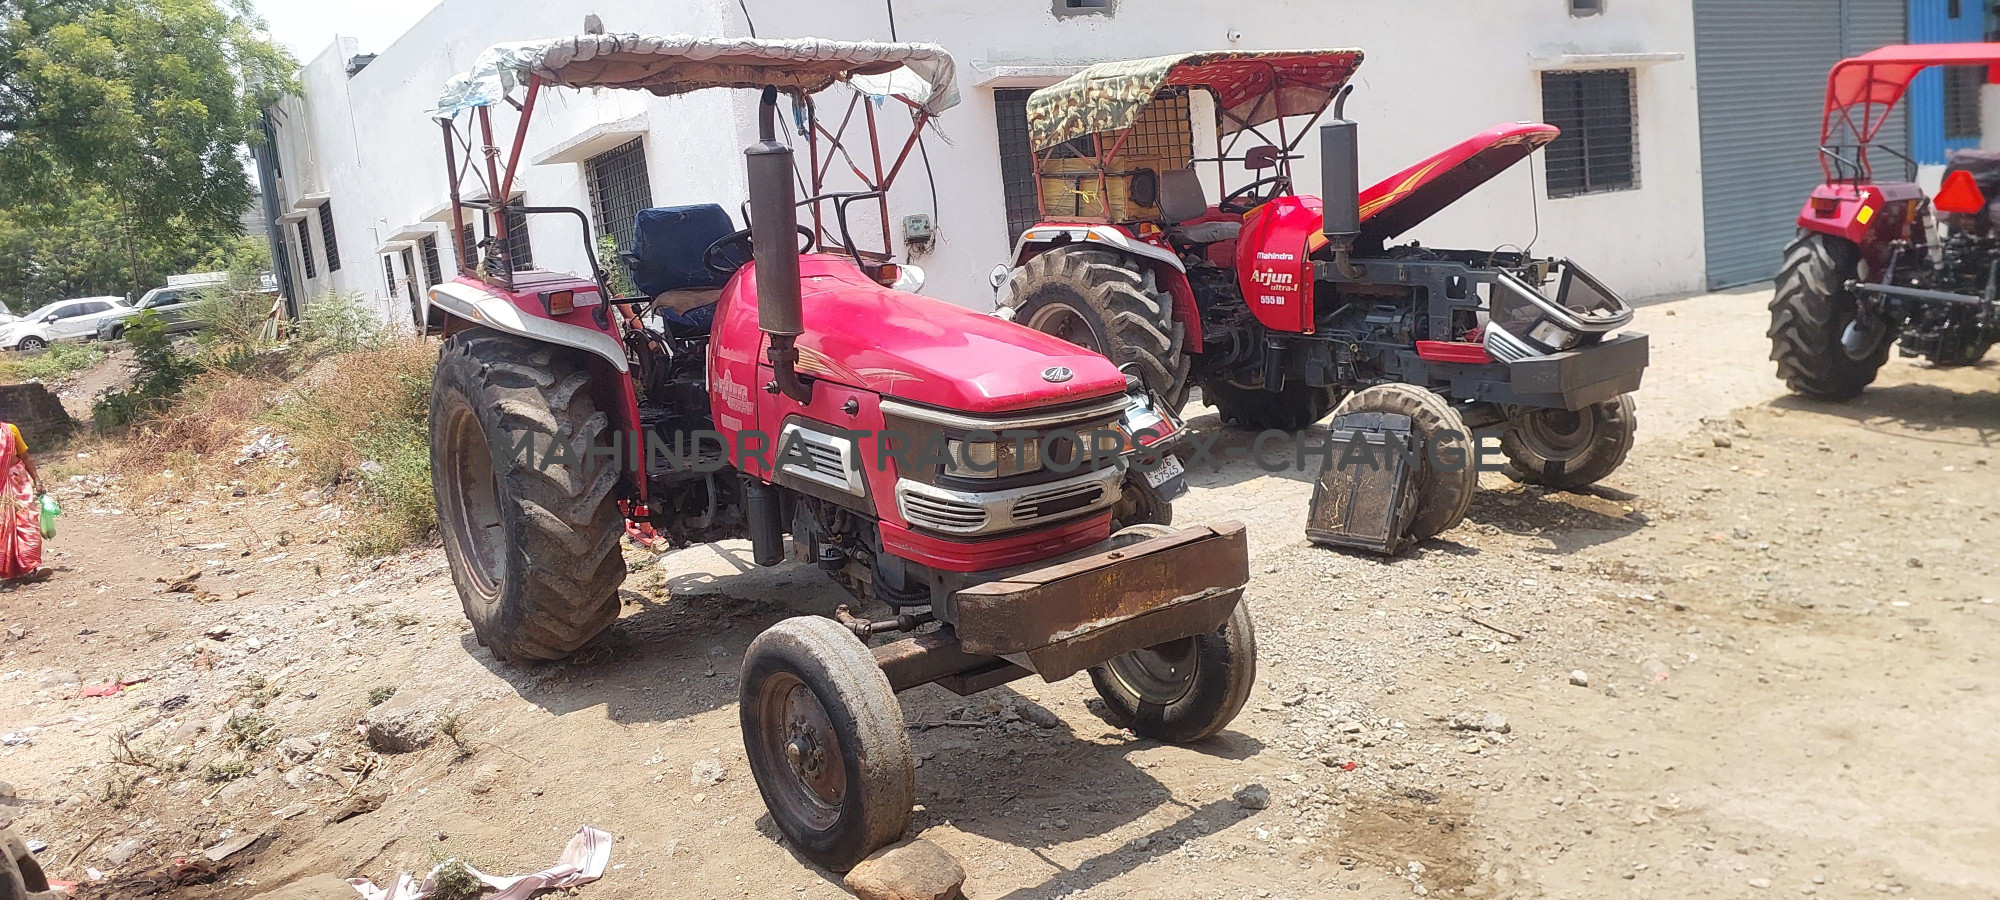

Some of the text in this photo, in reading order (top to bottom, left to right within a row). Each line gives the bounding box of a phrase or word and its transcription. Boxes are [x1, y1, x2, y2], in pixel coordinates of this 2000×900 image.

[1257, 252, 1293, 260] Mahindra
[1250, 268, 1293, 286] Arjun
[1270, 284, 1299, 292] ultra-1
[1260, 295, 1275, 305] 555
